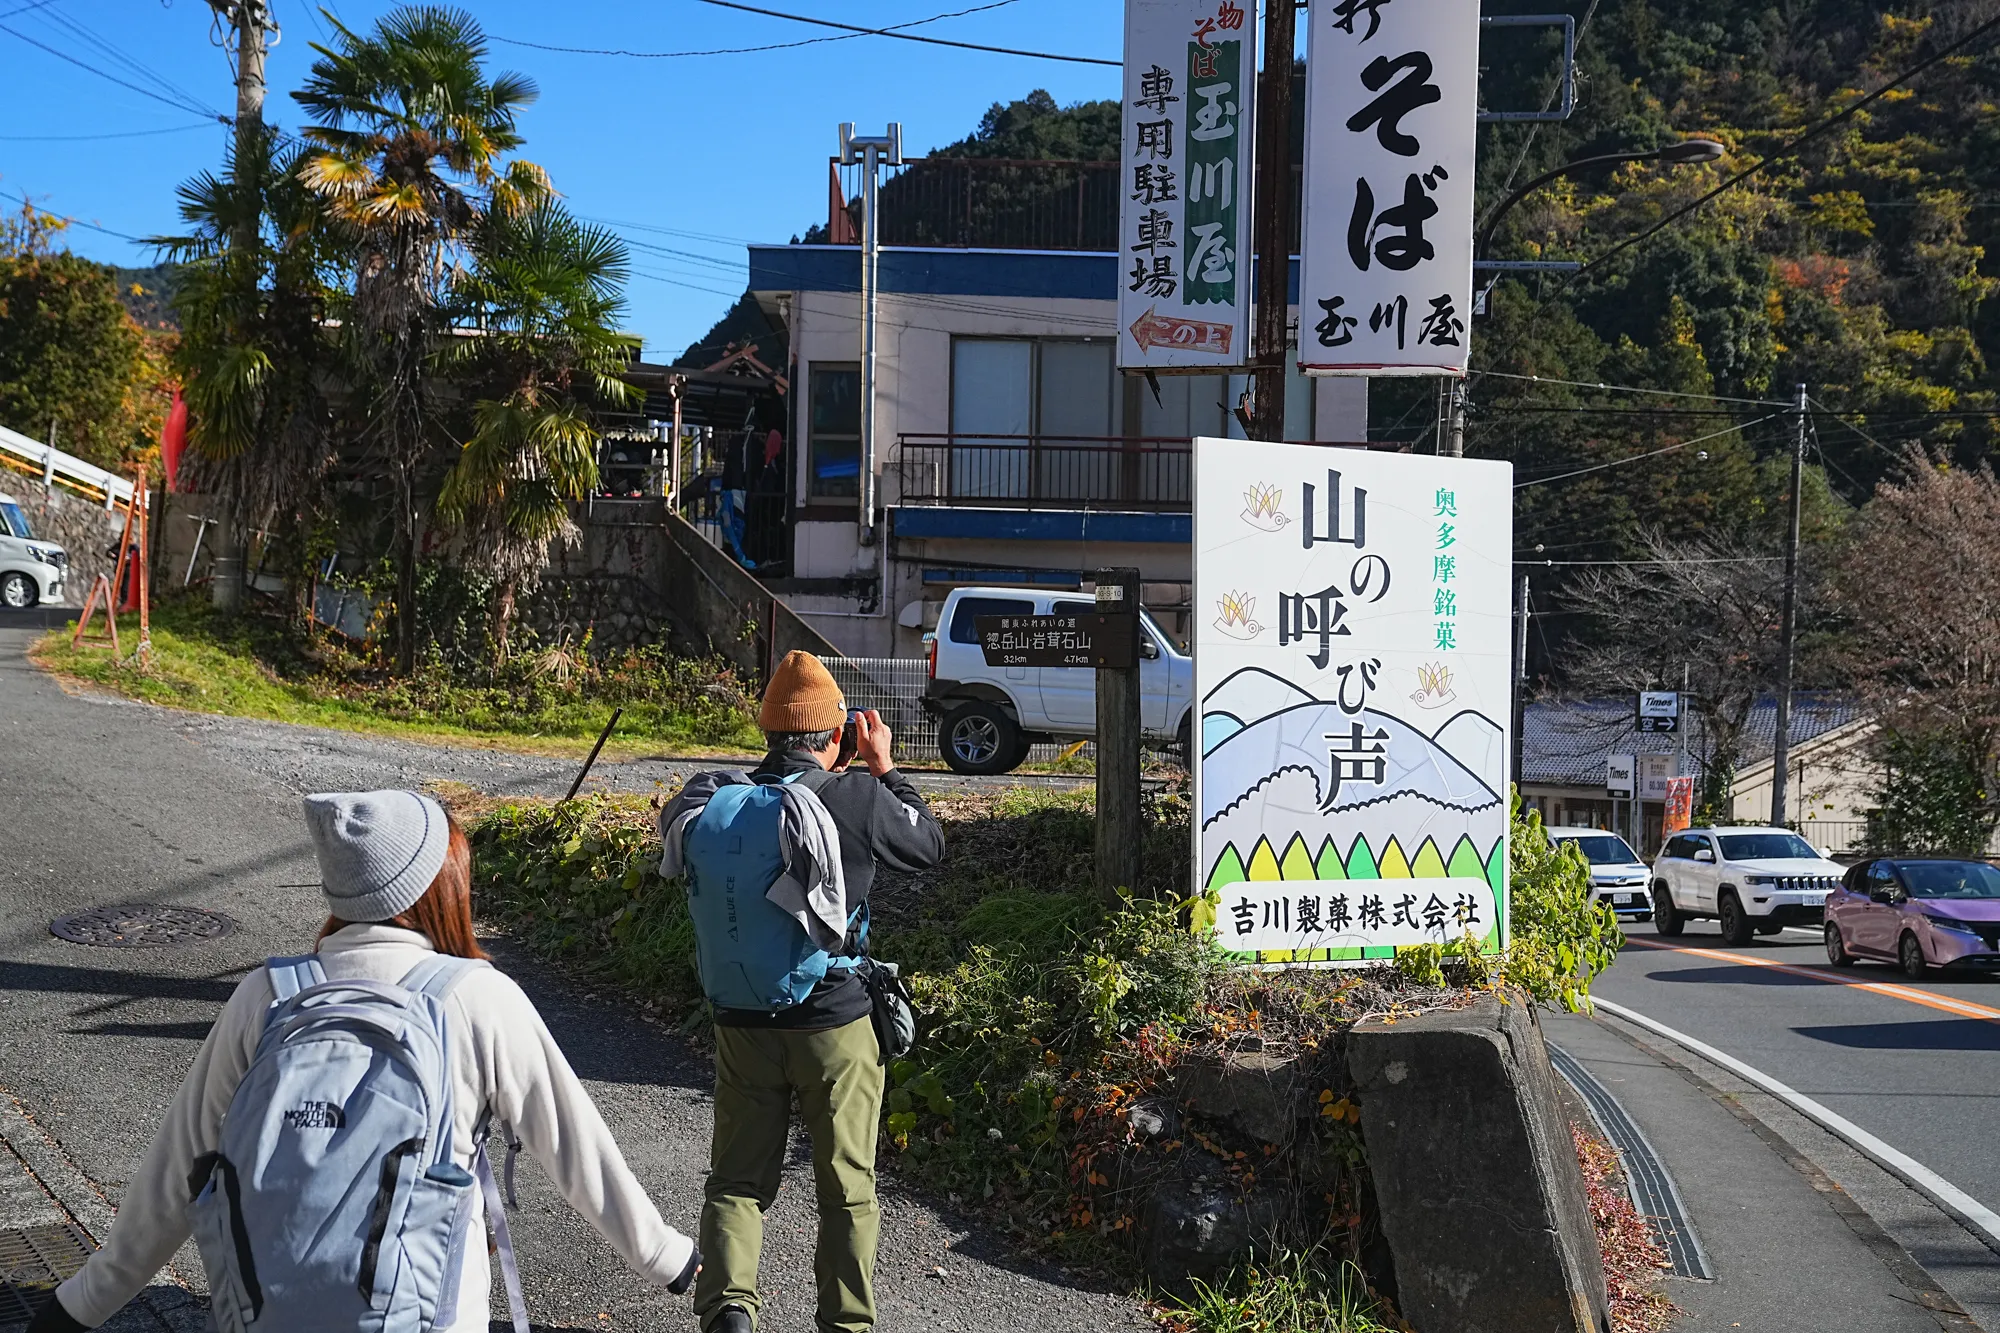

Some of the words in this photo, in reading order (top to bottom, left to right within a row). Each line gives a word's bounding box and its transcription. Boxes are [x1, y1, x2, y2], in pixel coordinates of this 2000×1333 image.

[1190, 16, 1222, 78] そば
[1127, 64, 1180, 299] 専用駐車場
[1187, 81, 1237, 284] 玉川屋
[1315, 293, 1464, 350] 玉川屋
[1149, 323, 1223, 350] この上
[1432, 487, 1458, 651] 奥多摩銘菓
[1001, 618, 1076, 629] 関東ふれあいの道
[1278, 468, 1391, 812] 山の呼び声
[1645, 697, 1673, 707] Times
[1609, 766, 1629, 780] Times
[726, 876, 735, 893] ICE
[727, 896, 737, 922] BLUE
[1230, 892, 1481, 936] 吉川製菓株式会社
[284, 1110, 325, 1120] NORTH
[303, 1101, 326, 1110] THE
[294, 1119, 324, 1128] FACE
